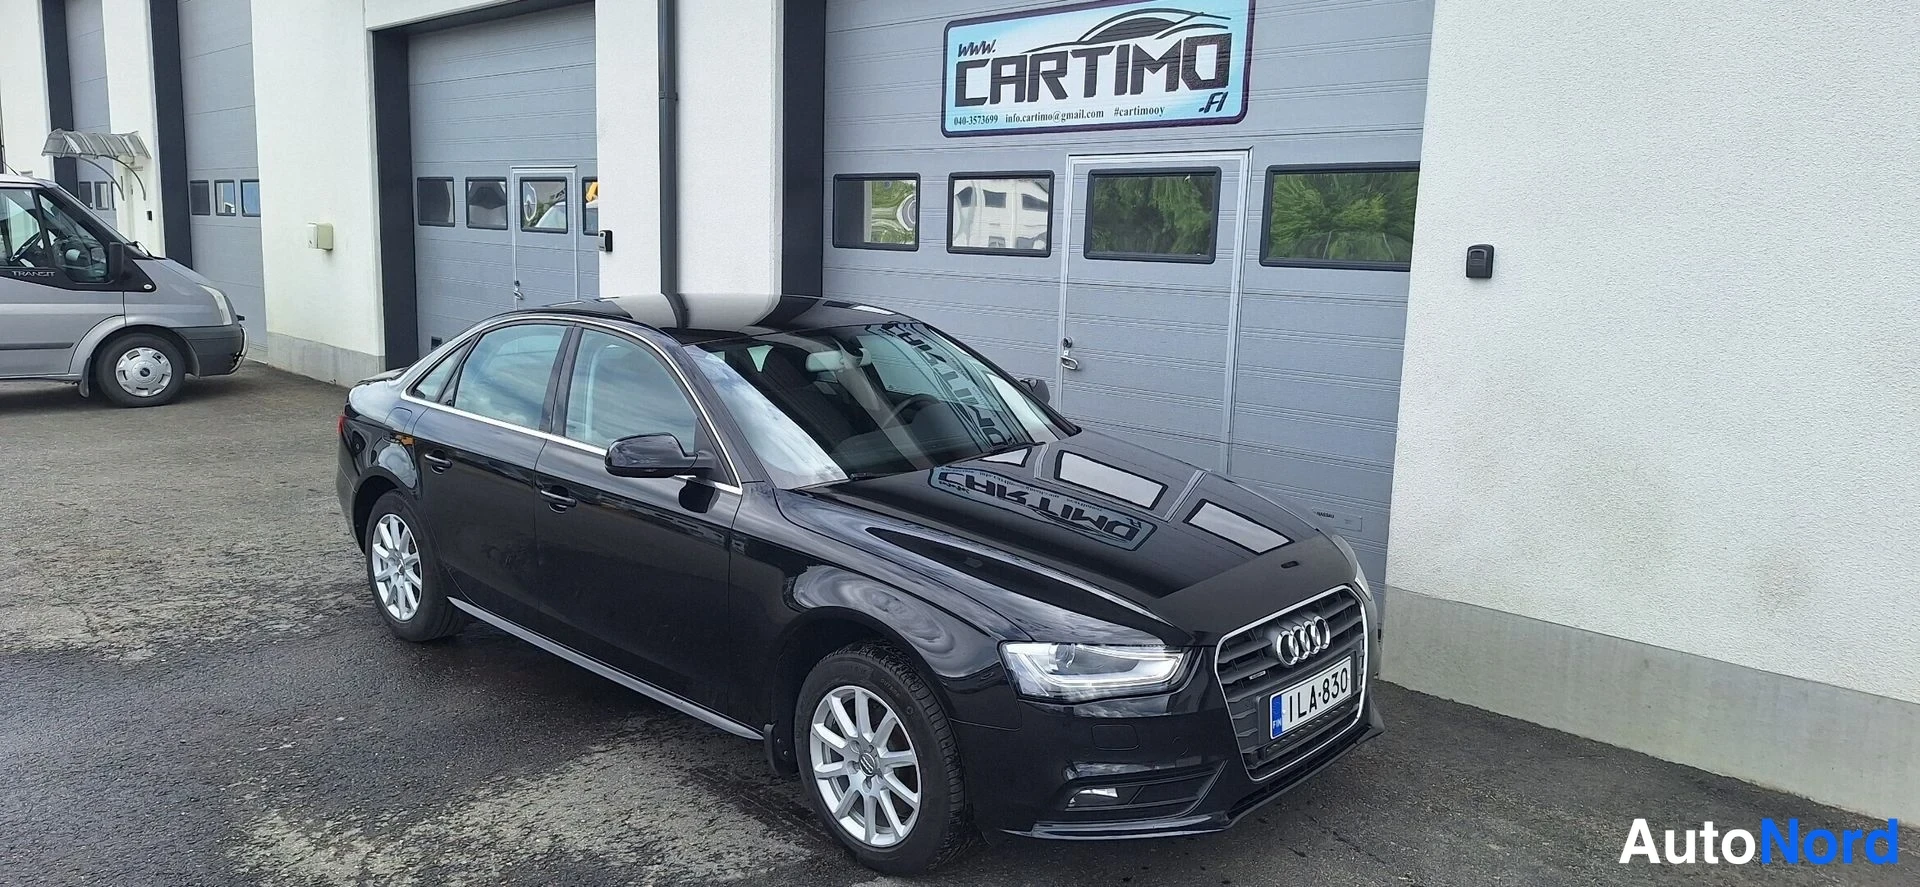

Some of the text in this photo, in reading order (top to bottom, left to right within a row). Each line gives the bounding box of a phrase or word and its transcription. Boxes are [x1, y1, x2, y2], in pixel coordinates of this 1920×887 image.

[954, 33, 1232, 107] CARTIMO
[953, 105, 1165, 126] 040-3573699 info.cartimo@gmail.com #cartimooy
